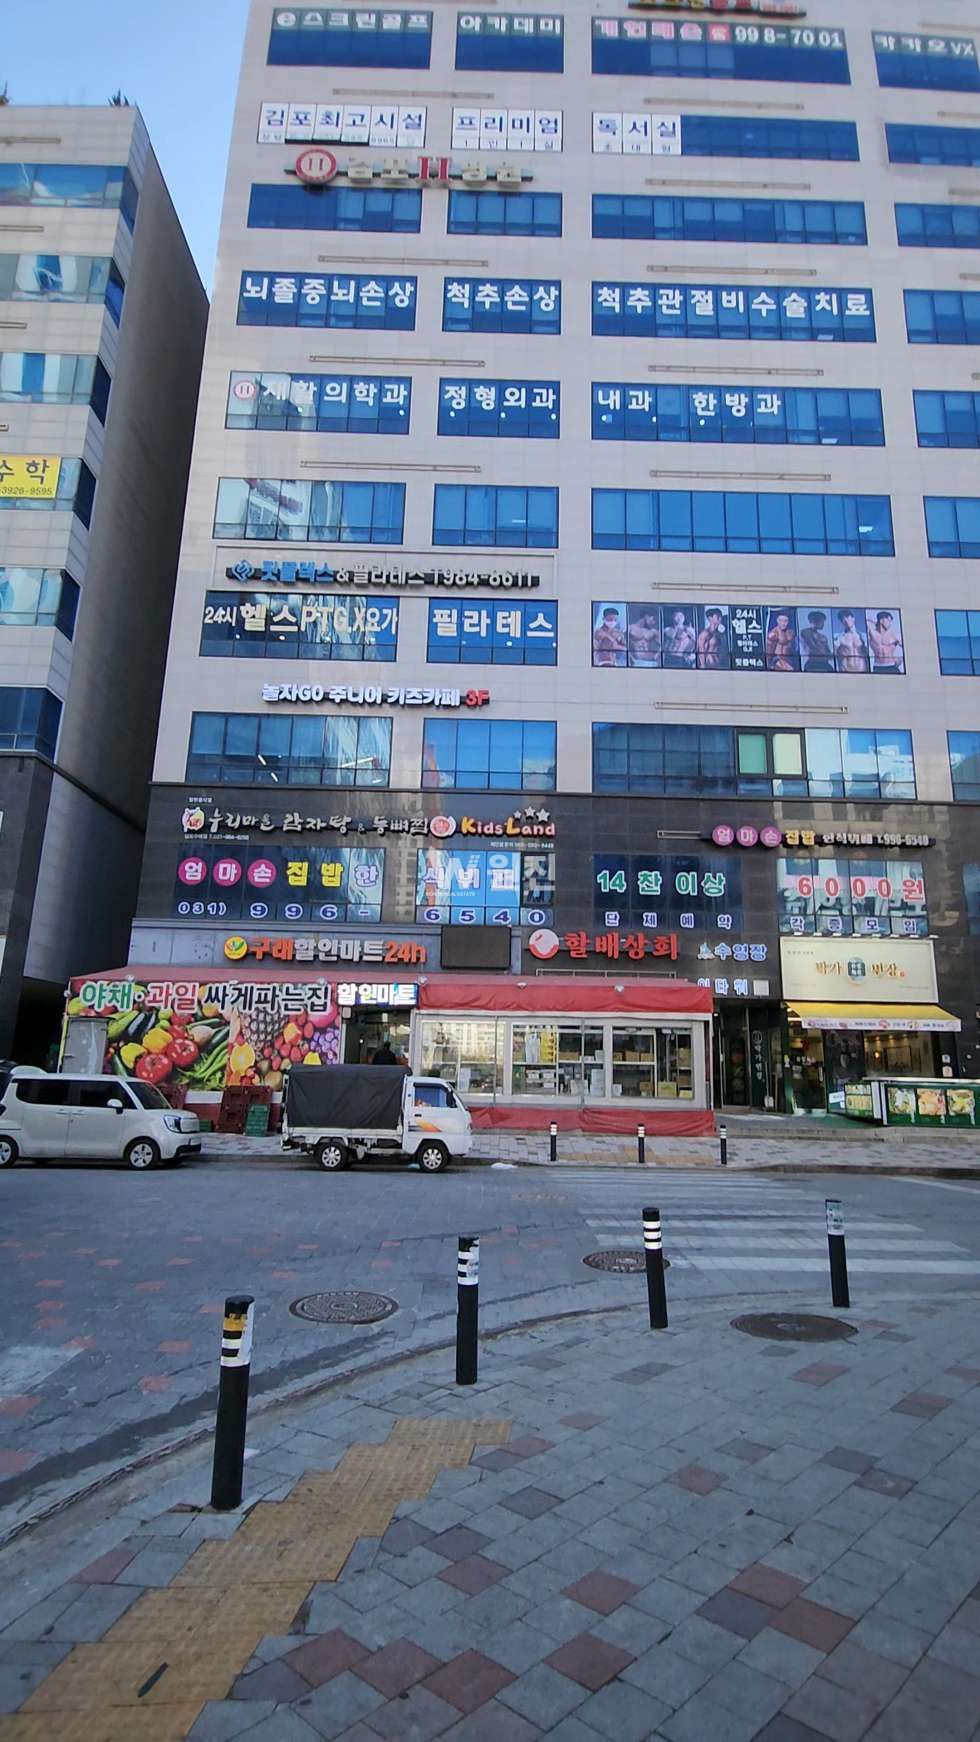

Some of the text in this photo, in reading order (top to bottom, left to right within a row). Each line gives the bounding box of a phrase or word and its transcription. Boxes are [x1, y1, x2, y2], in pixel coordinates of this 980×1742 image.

[735, 25, 843, 47] 998-7001
[266, 109, 423, 130] 김포최고시설
[456, 116, 558, 134] 프리미엄
[598, 118, 677, 138] 독서실
[242, 276, 414, 308] 뇌졸중뇌손상
[446, 282, 559, 312] 척추손상
[597, 287, 870, 317] 척추관절비수술치료
[444, 385, 556, 411] 정형외과
[597, 389, 652, 411] 내과
[692, 391, 781, 417] 한방과
[0, 459, 50, 485] 수학
[204, 606, 236, 628] 24시
[240, 602, 299, 632] 헬스
[433, 608, 555, 637] 필라테스
[732, 618, 763, 634] 헬스
[735, 608, 756, 619] 24시
[328, 685, 382, 704] 주니어
[387, 686, 460, 706] 키즈카페
[465, 688, 490, 706] 3F
[184, 862, 272, 883] 엄마손
[287, 862, 344, 887] 집밥
[564, 931, 679, 960] 할배상회
[714, 942, 768, 961] 수영장
